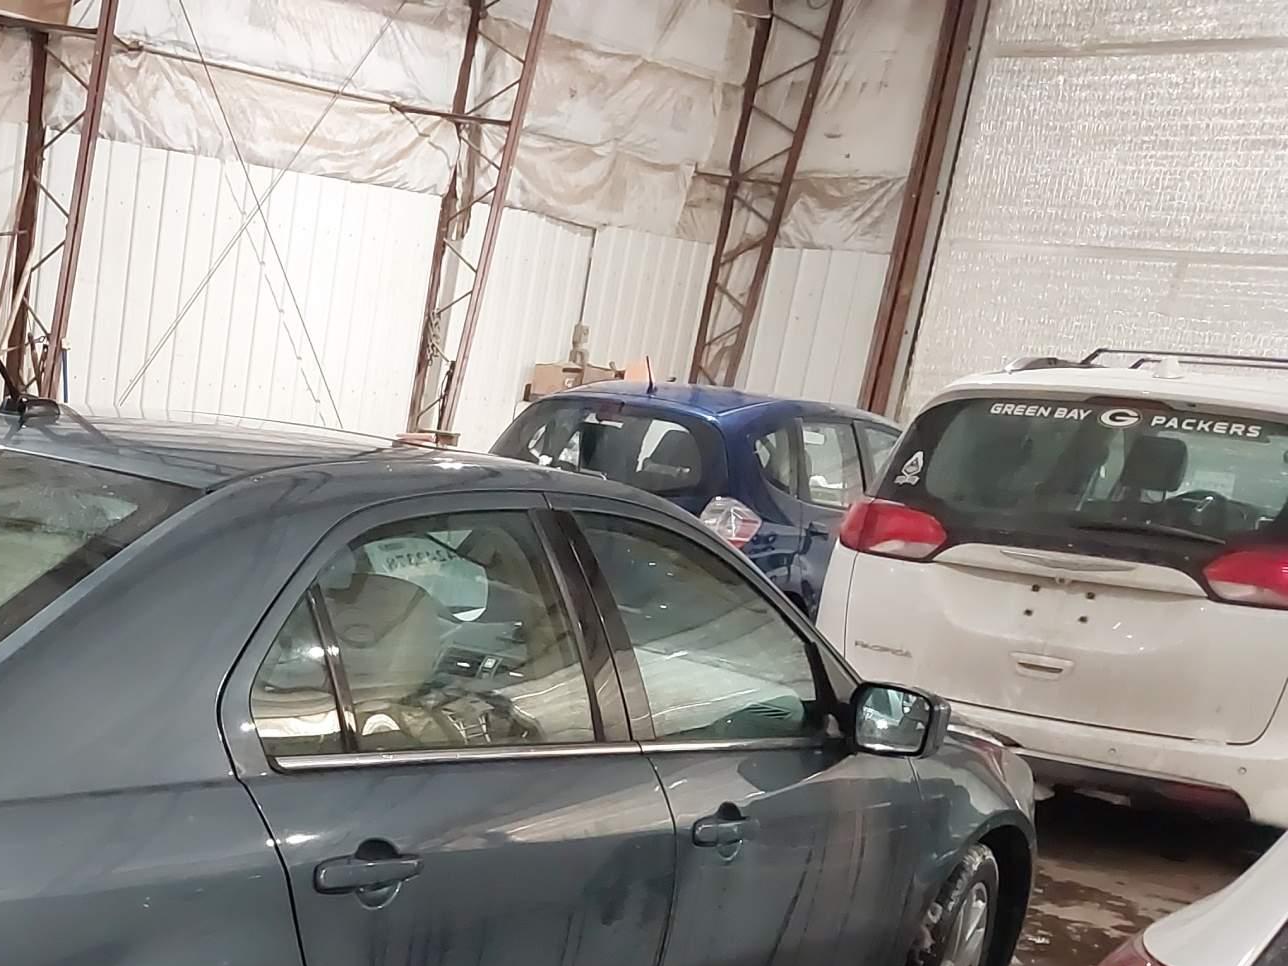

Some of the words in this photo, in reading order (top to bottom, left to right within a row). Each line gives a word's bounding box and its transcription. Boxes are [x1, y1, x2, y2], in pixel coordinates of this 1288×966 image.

[989, 402, 1052, 418] GREEN
[1053, 407, 1093, 421] BAY
[1099, 408, 1141, 427] G
[1150, 415, 1262, 438] PACKERS
